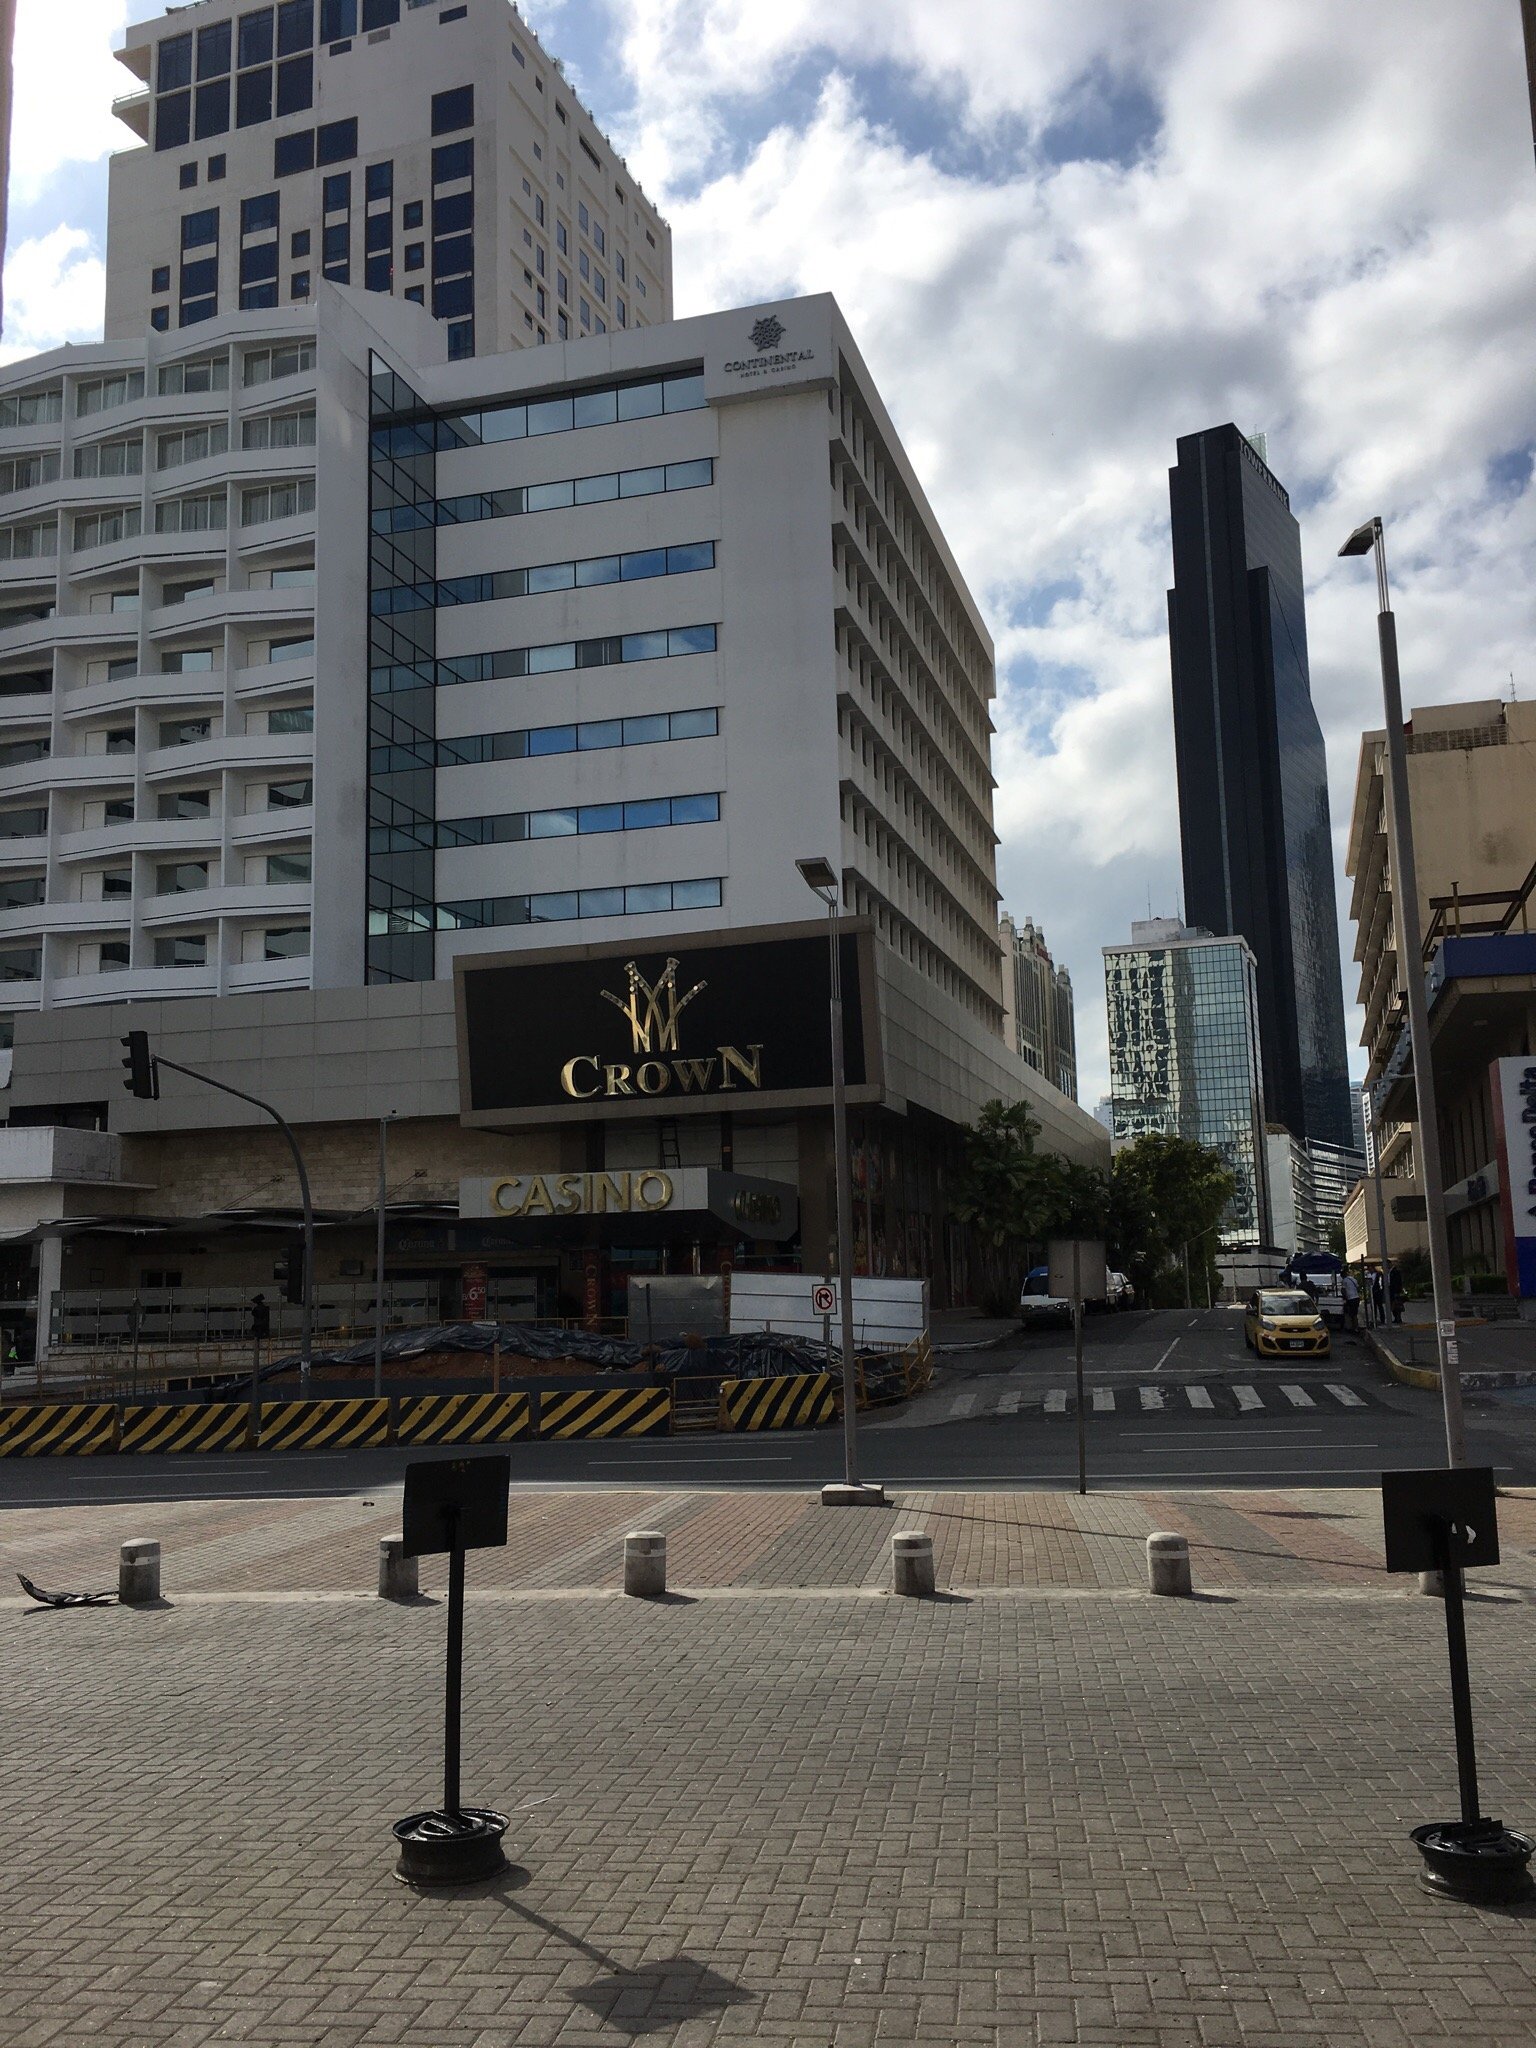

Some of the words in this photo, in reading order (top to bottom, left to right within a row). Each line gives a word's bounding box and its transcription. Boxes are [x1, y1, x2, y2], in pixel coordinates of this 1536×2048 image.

[724, 349, 814, 373] CONTINENTAL
[741, 370, 760, 378] HOTEL
[771, 364, 797, 373] CASINO
[1238, 435, 1288, 510] TOWERBANK
[560, 1044, 764, 1099] CROWN
[488, 1170, 674, 1218] CASINO
